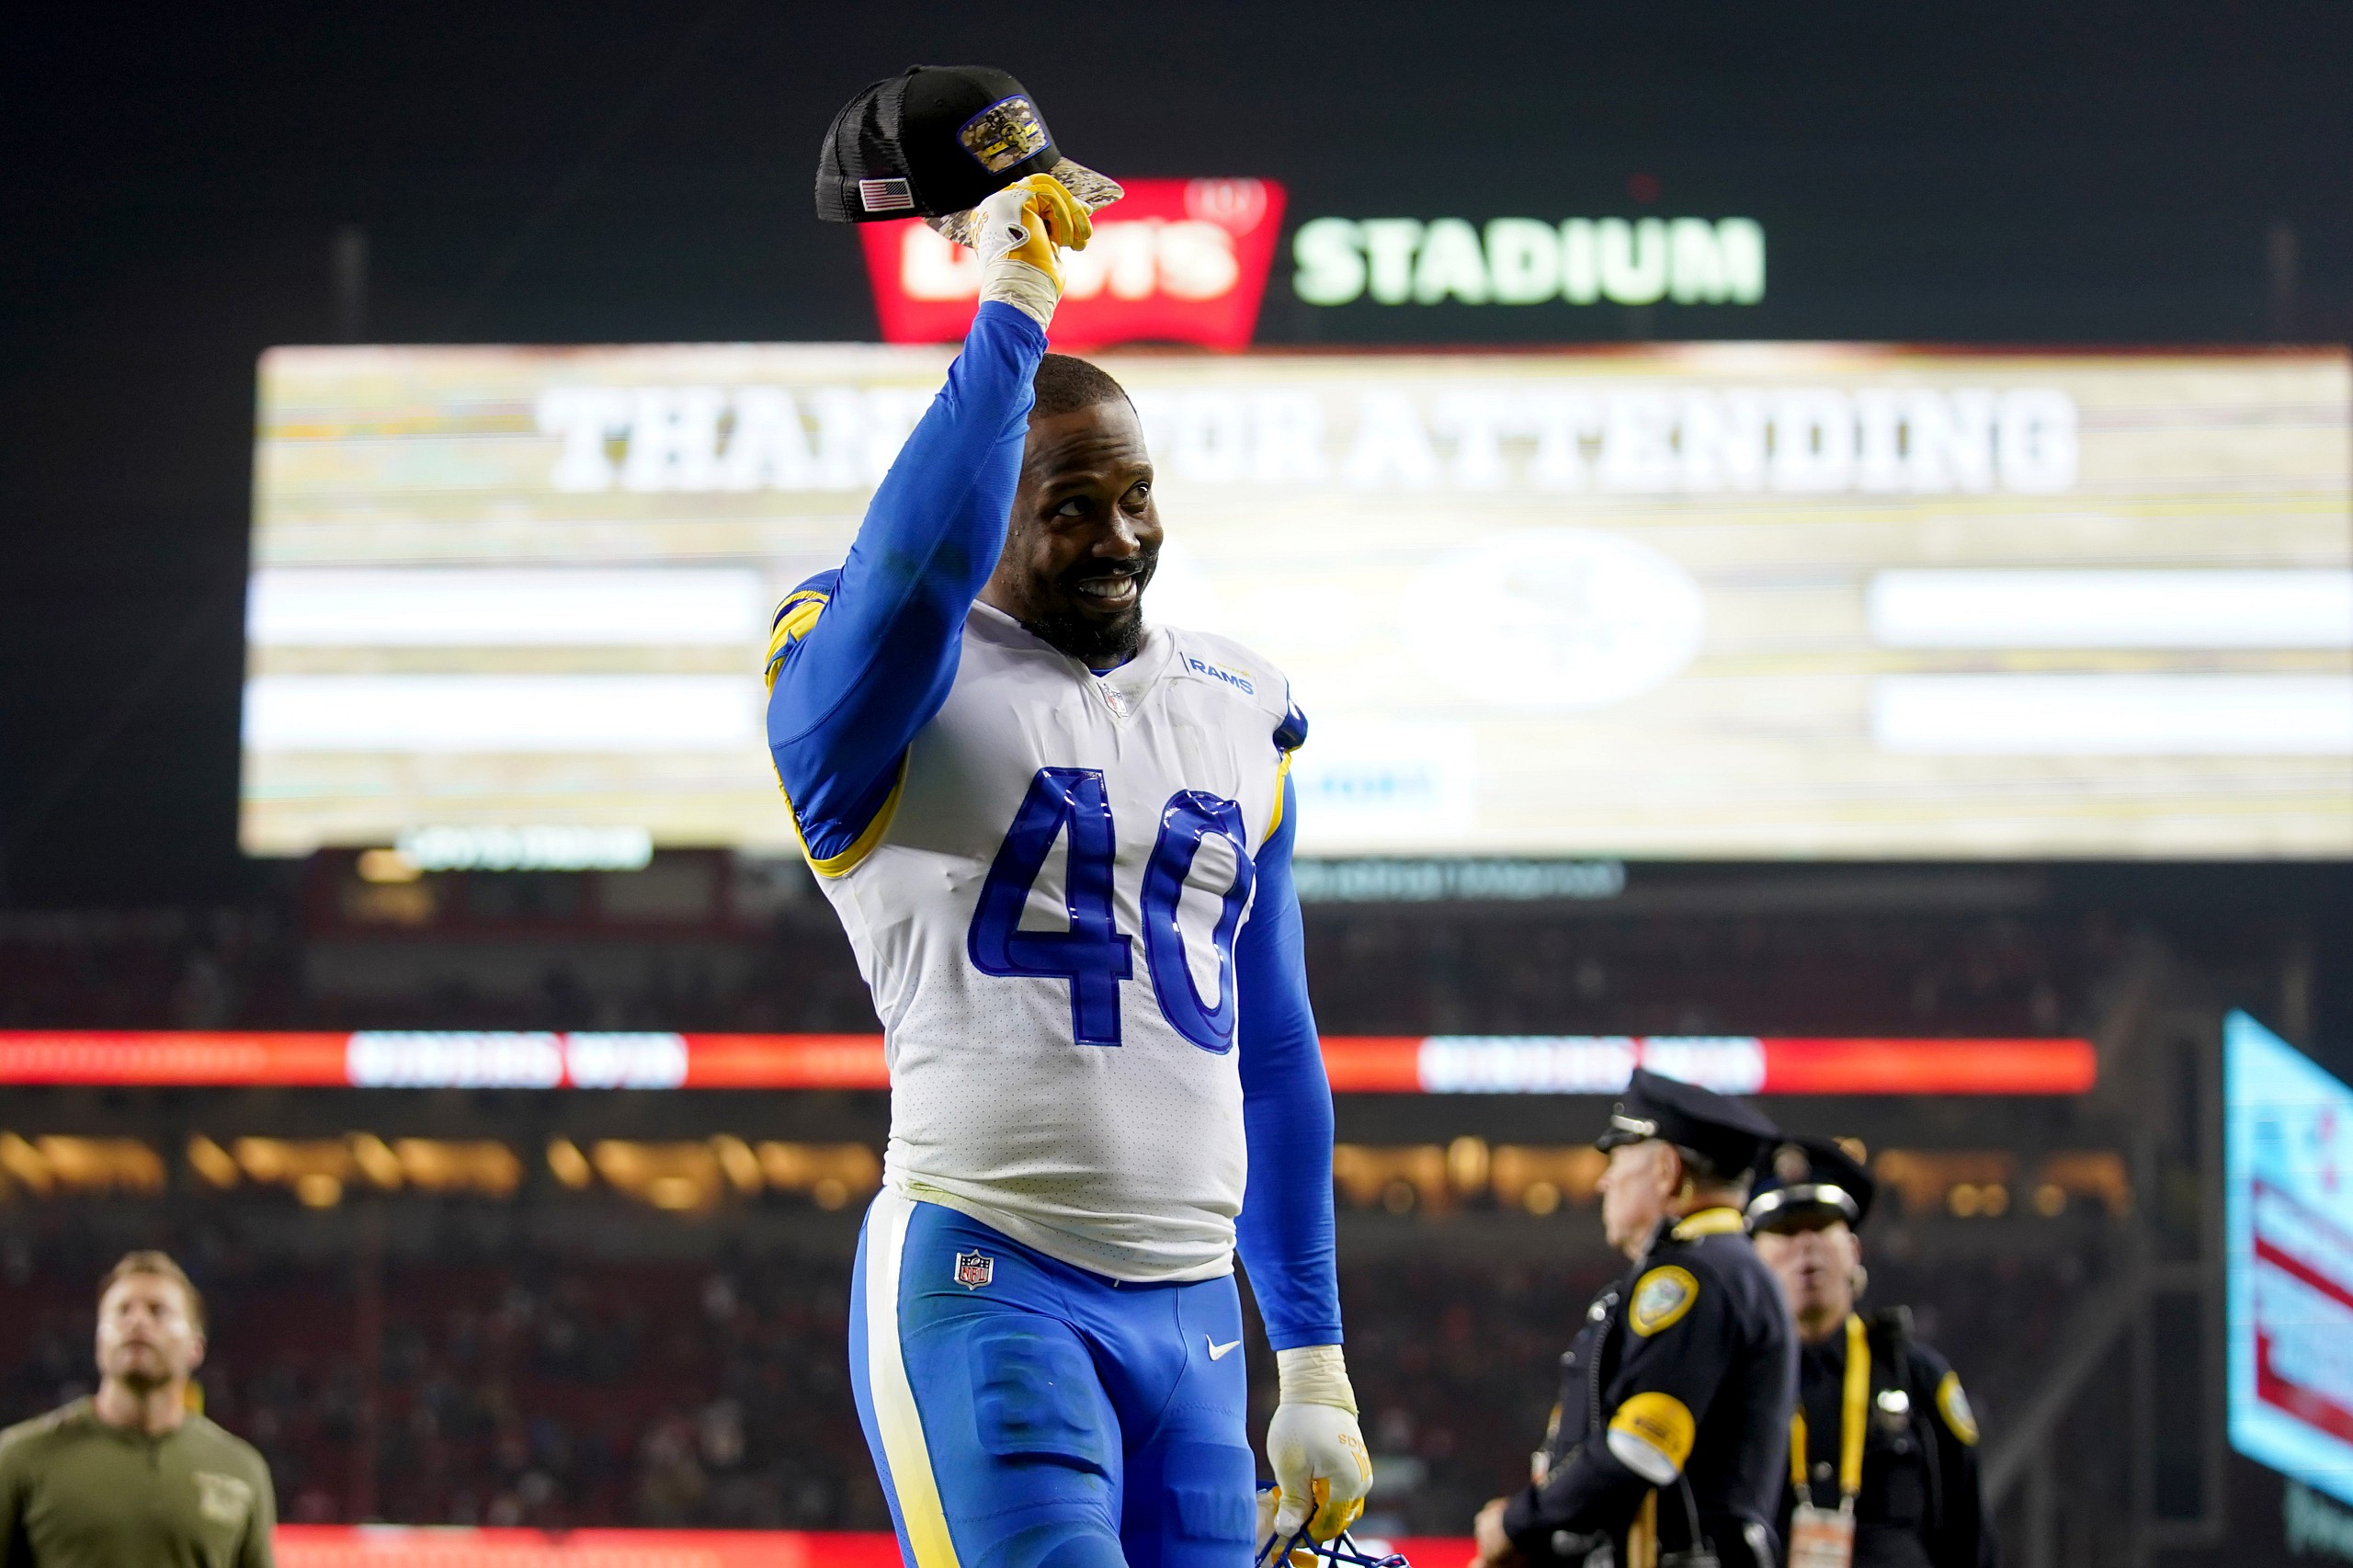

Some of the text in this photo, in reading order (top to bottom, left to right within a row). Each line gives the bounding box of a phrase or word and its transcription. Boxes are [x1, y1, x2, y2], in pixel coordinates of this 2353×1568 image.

[1292, 217, 1767, 304] STADIUM
[1344, 390, 2077, 492] ATTENDING
[1188, 658, 1255, 696] RAMS
[967, 766, 1256, 1055] 40
[962, 1267, 986, 1282] NFL
